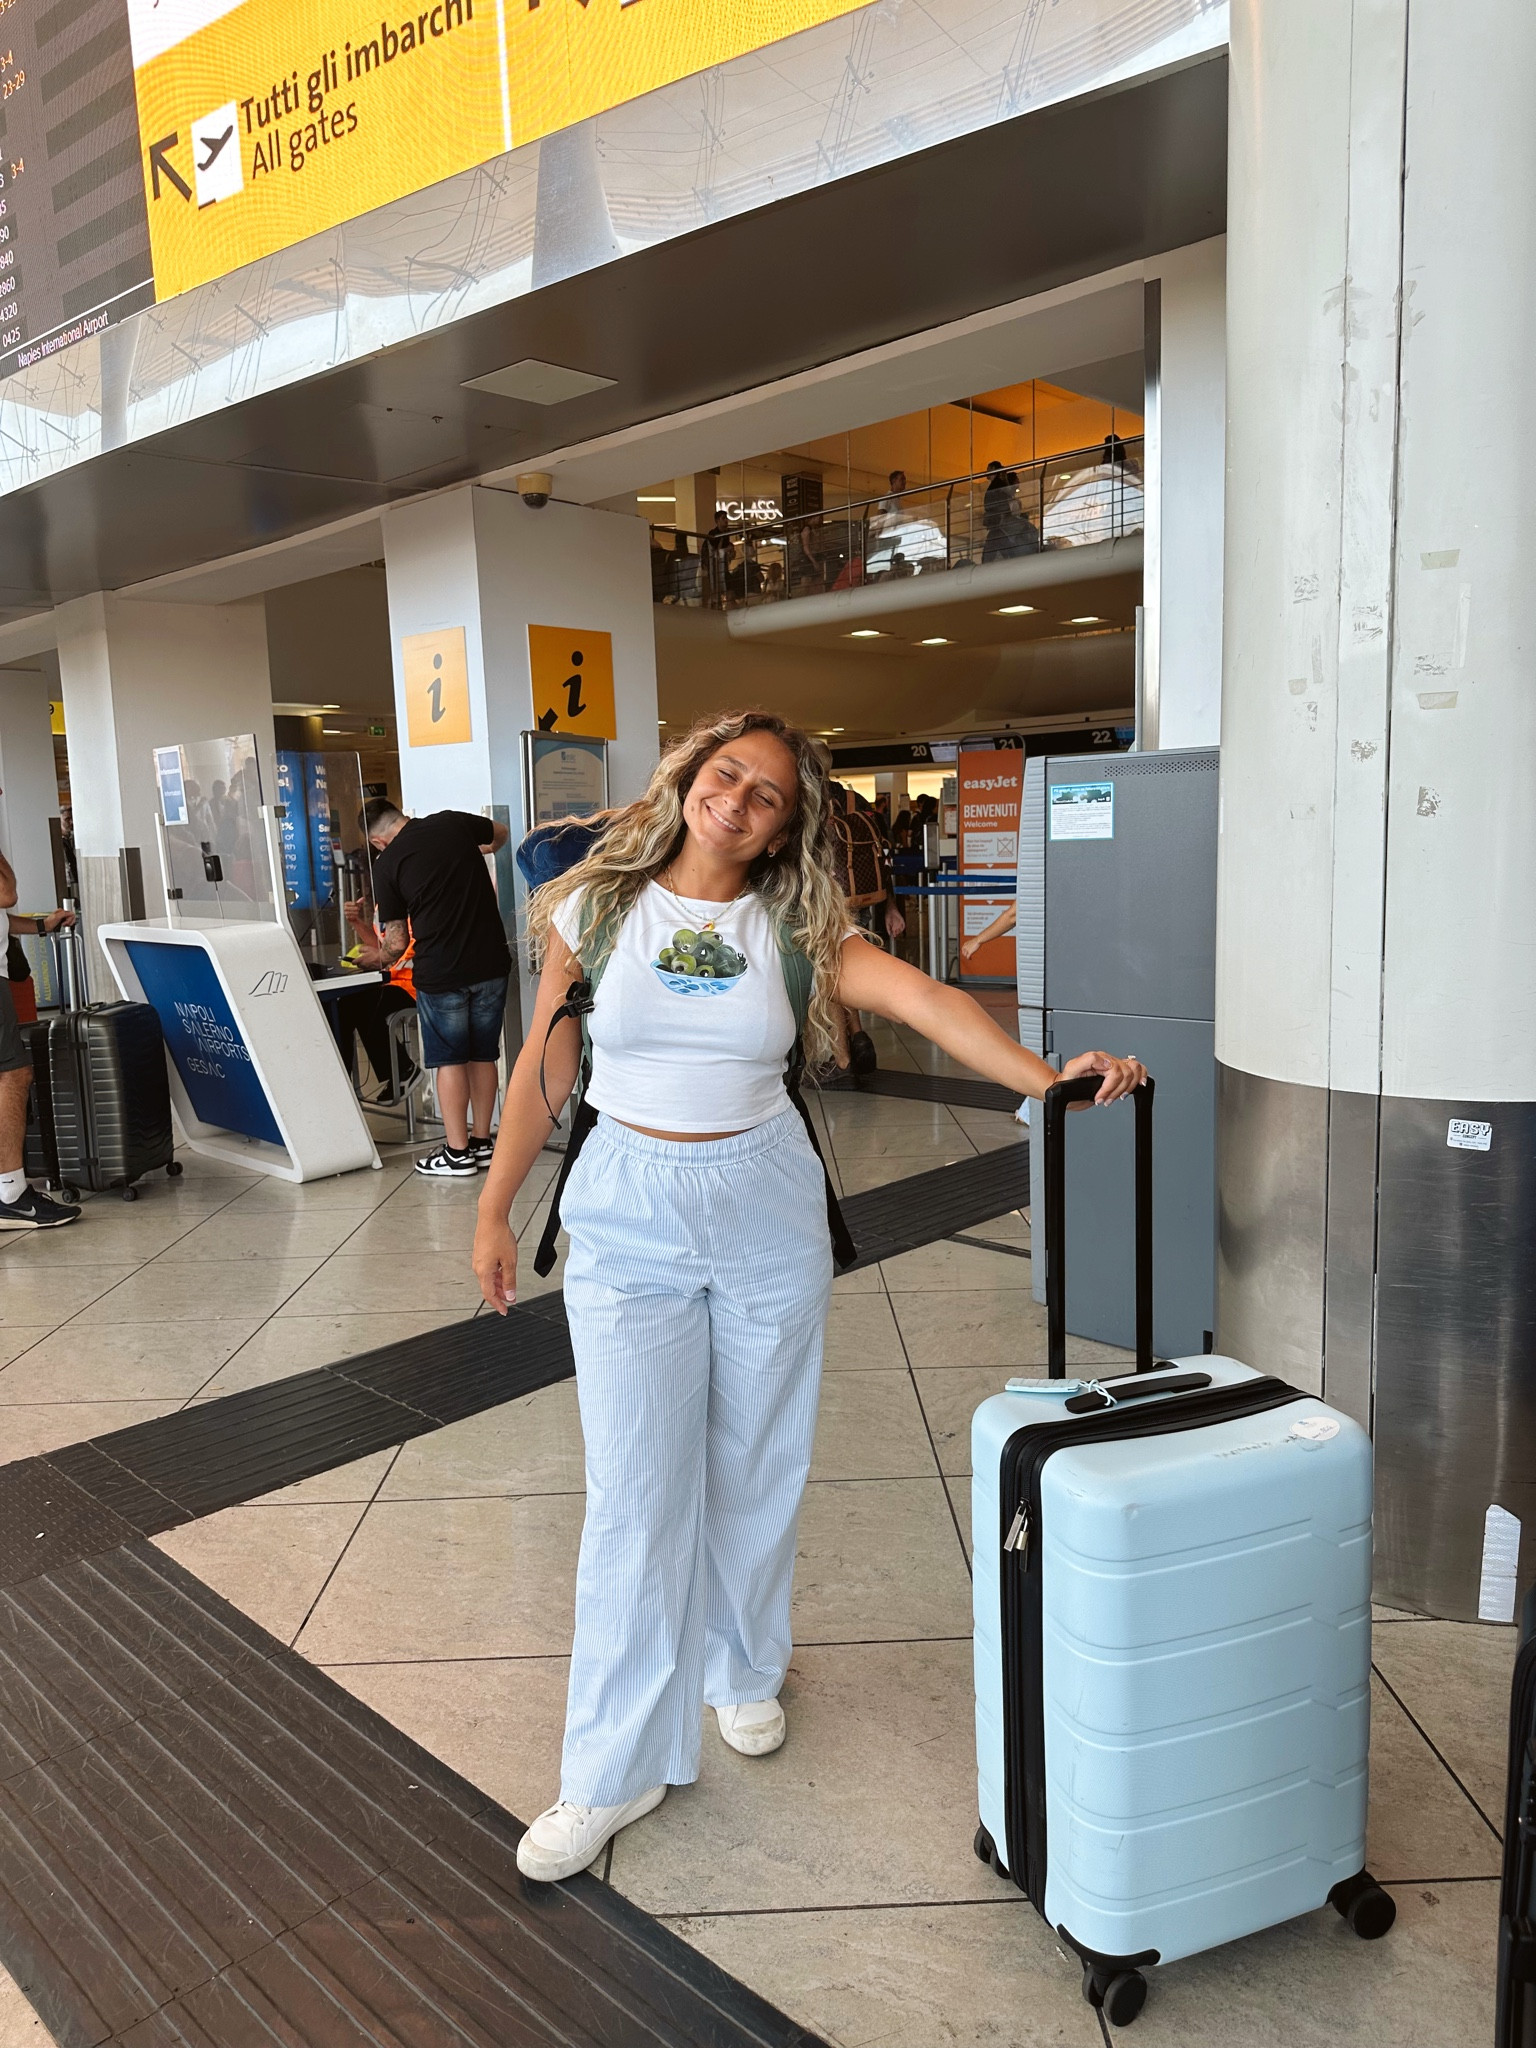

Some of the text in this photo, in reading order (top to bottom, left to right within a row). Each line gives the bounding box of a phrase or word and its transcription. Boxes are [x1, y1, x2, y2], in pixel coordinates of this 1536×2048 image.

[3, 70, 26, 100] 23-29
[240, 71, 300, 134] Tutti
[307, 50, 338, 113] gli
[252, 102, 359, 180] All gates
[11, 157, 25, 180] 3-4
[3, 326, 21, 348] 0425
[17, 310, 109, 367] Naples International Airport
[1000, 738, 1017, 750] 21
[1091, 730, 1113, 744] 22
[911, 744, 928, 757] 20
[963, 776, 1018, 791] easyJet
[963, 802, 1018, 819] BENVENUTI
[963, 820, 998, 829] Welcome
[174, 1001, 216, 1023] NAPOLI
[182, 1018, 234, 1042] SALERNO
[198, 1037, 252, 1062] AIRPORTS
[1451, 1120, 1491, 1136] EASY
